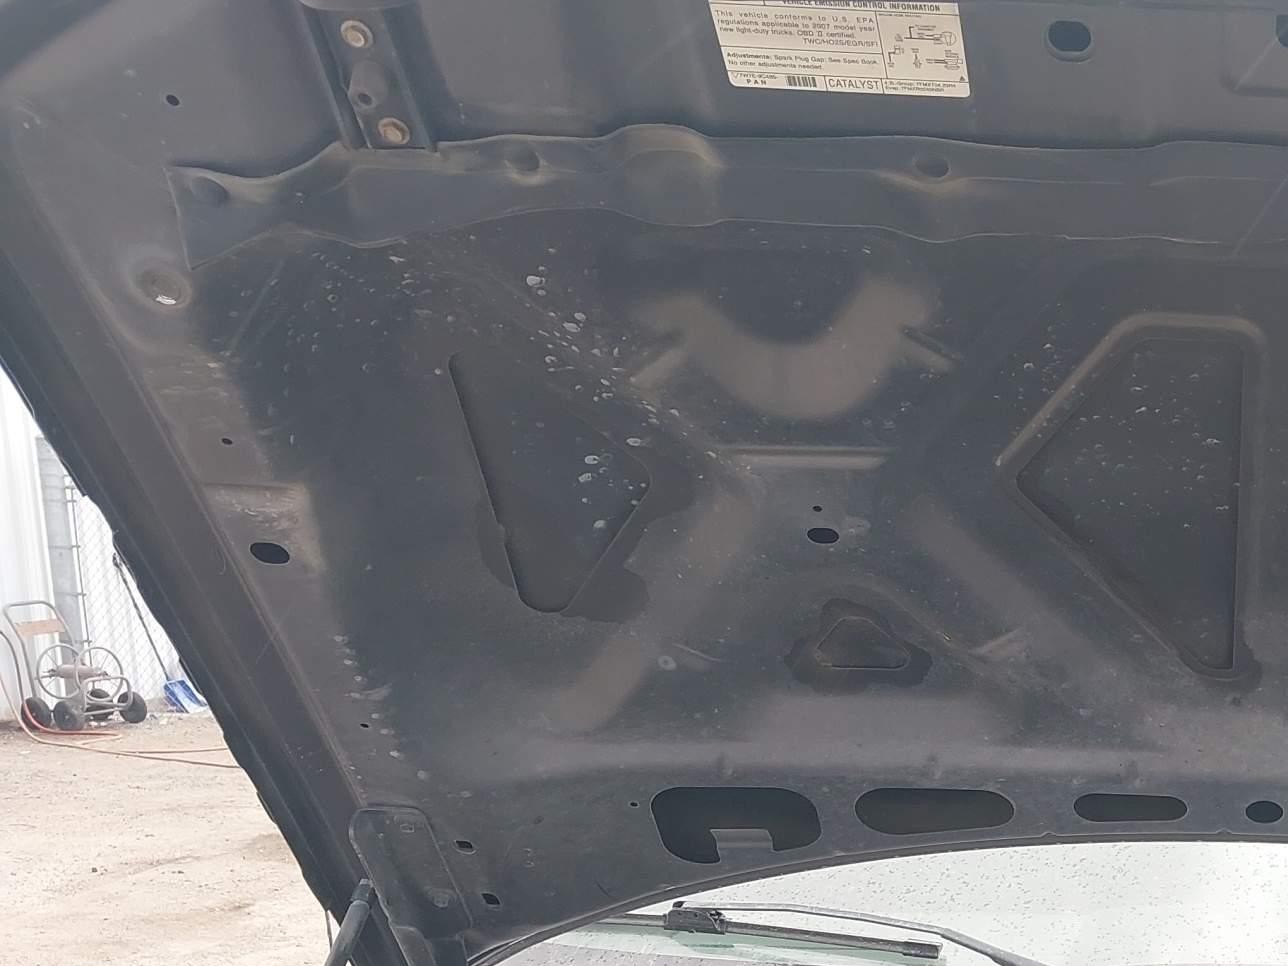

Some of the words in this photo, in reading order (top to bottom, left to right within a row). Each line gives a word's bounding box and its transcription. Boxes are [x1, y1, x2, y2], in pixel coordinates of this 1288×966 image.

[853, 1, 887, 10] CONTROL
[889, 3, 941, 12] INFORMATION
[715, 9, 733, 17] This
[739, 11, 769, 19] vehicle
[774, 13, 813, 21] conforms
[856, 16, 874, 24] EPA
[717, 18, 759, 28] regulations
[761, 20, 800, 29] applicable
[812, 22, 831, 30] 2007
[833, 23, 856, 31] model
[736, 26, 770, 36] light-duty
[797, 29, 815, 37] OBD
[826, 31, 857, 39] certified.
[727, 52, 772, 61] Adjustments:
[774, 54, 792, 62] Spark
[794, 55, 809, 63] Plug
[758, 61, 797, 70] adjustments
[828, 78, 880, 90] CATALYST
